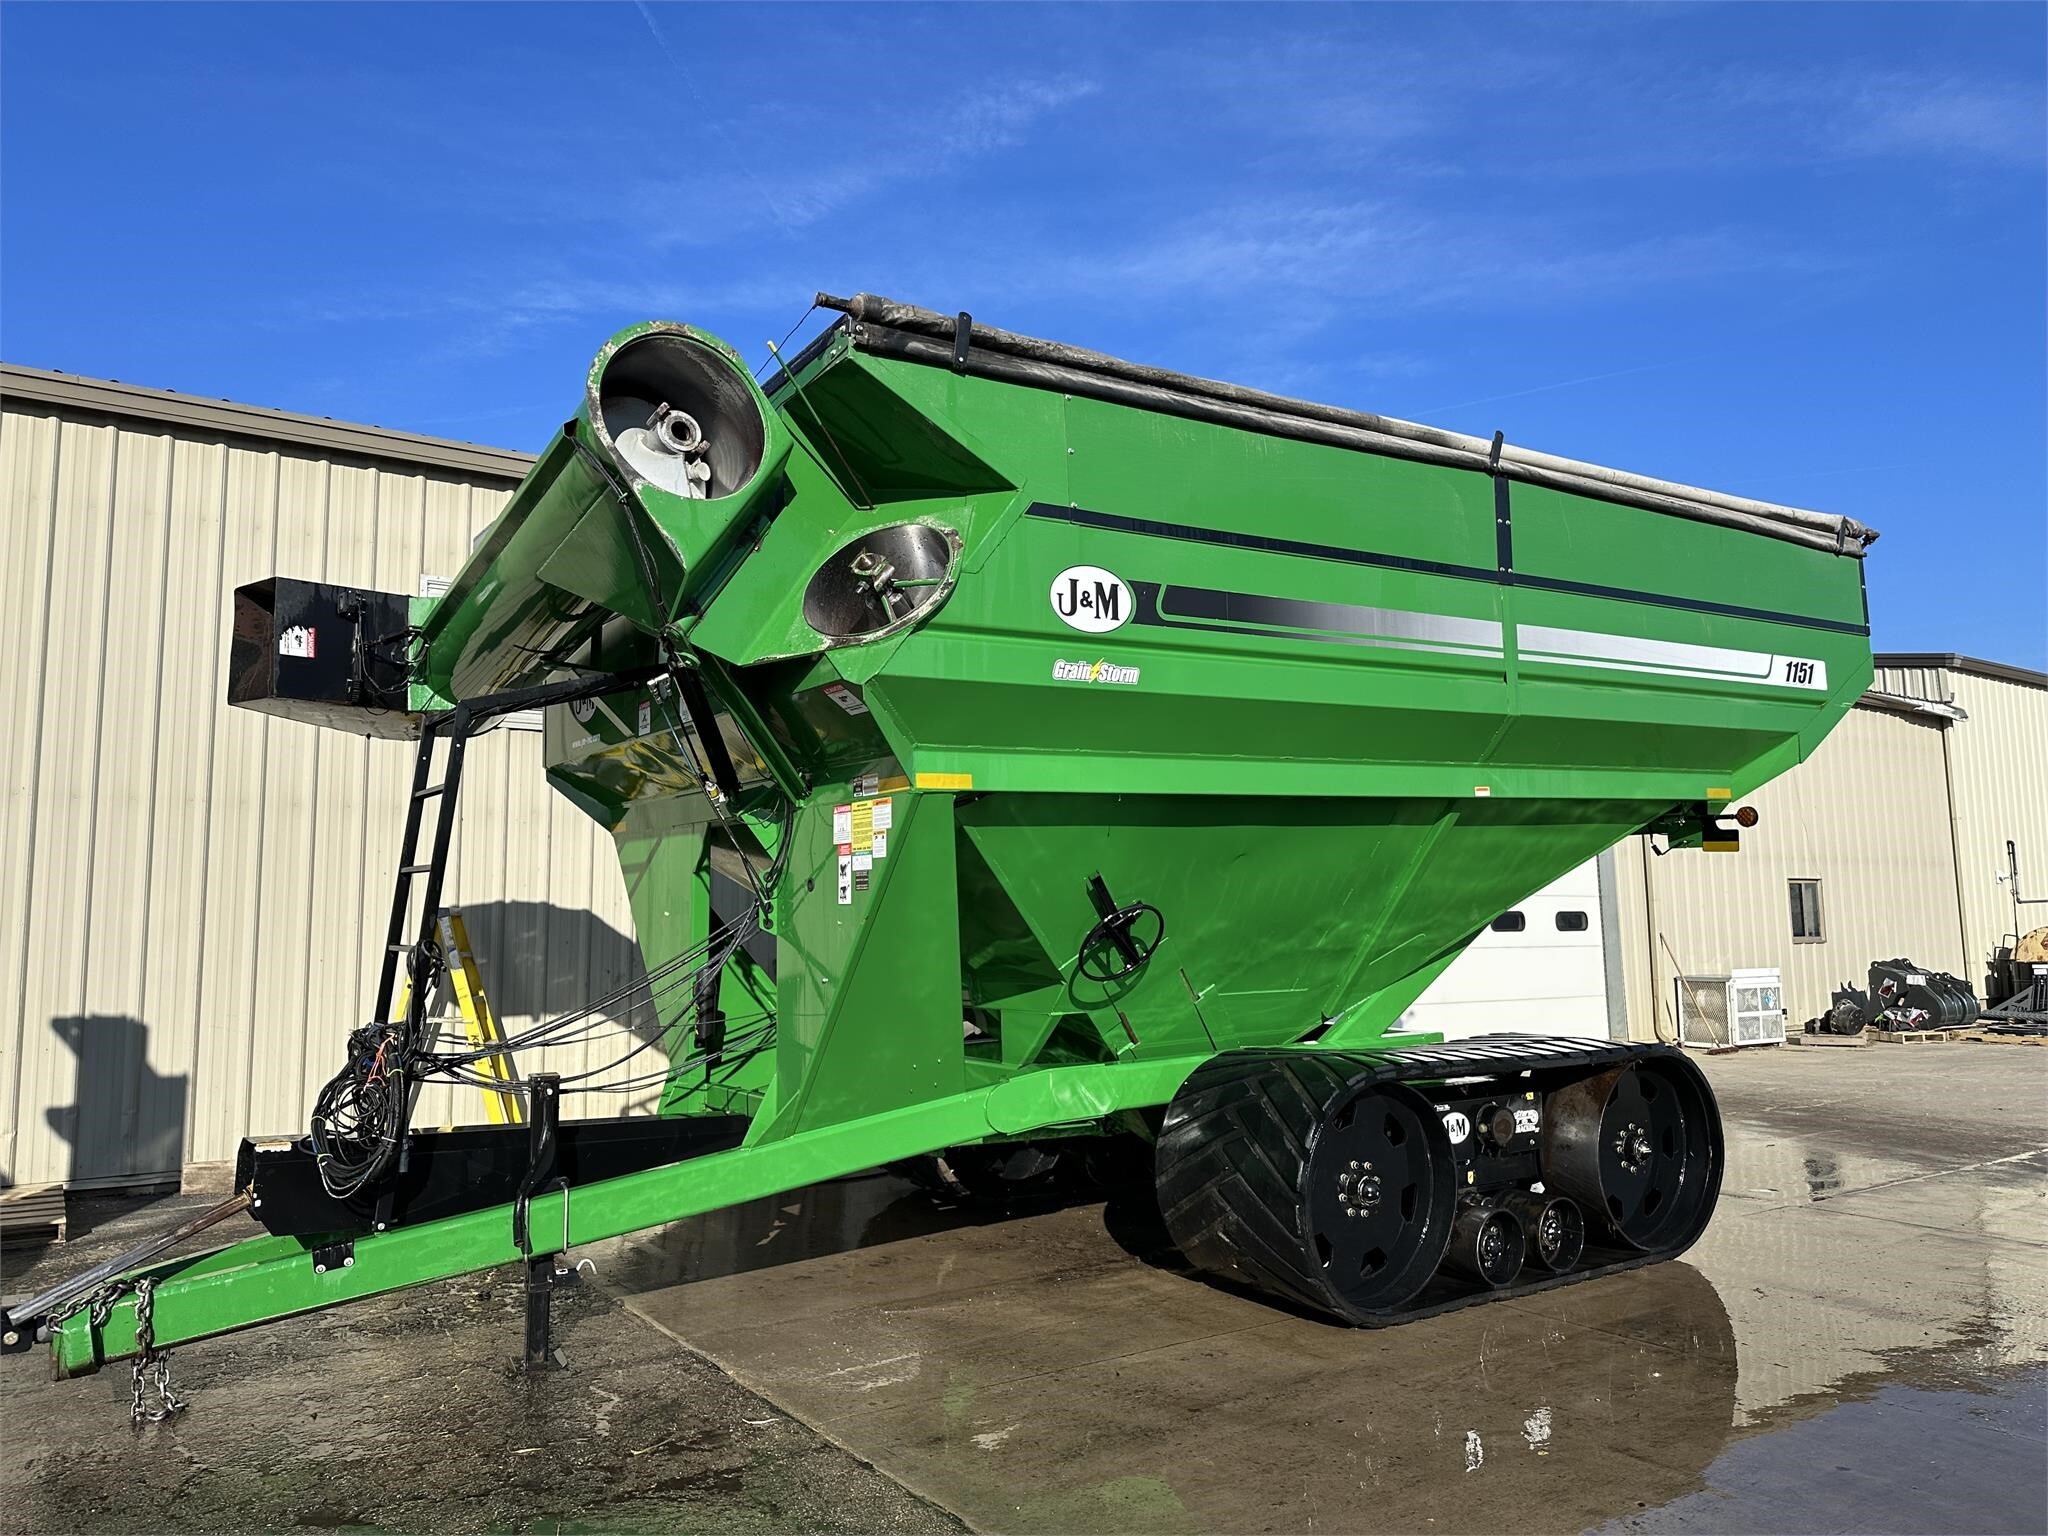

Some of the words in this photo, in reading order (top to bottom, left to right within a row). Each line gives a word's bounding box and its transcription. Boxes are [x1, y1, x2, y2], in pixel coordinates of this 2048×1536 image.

[1056, 578, 1120, 621] J&M
[1053, 659, 1092, 681] Grain
[1097, 662, 1139, 684] Storm
[1785, 661, 1815, 685] 1151
